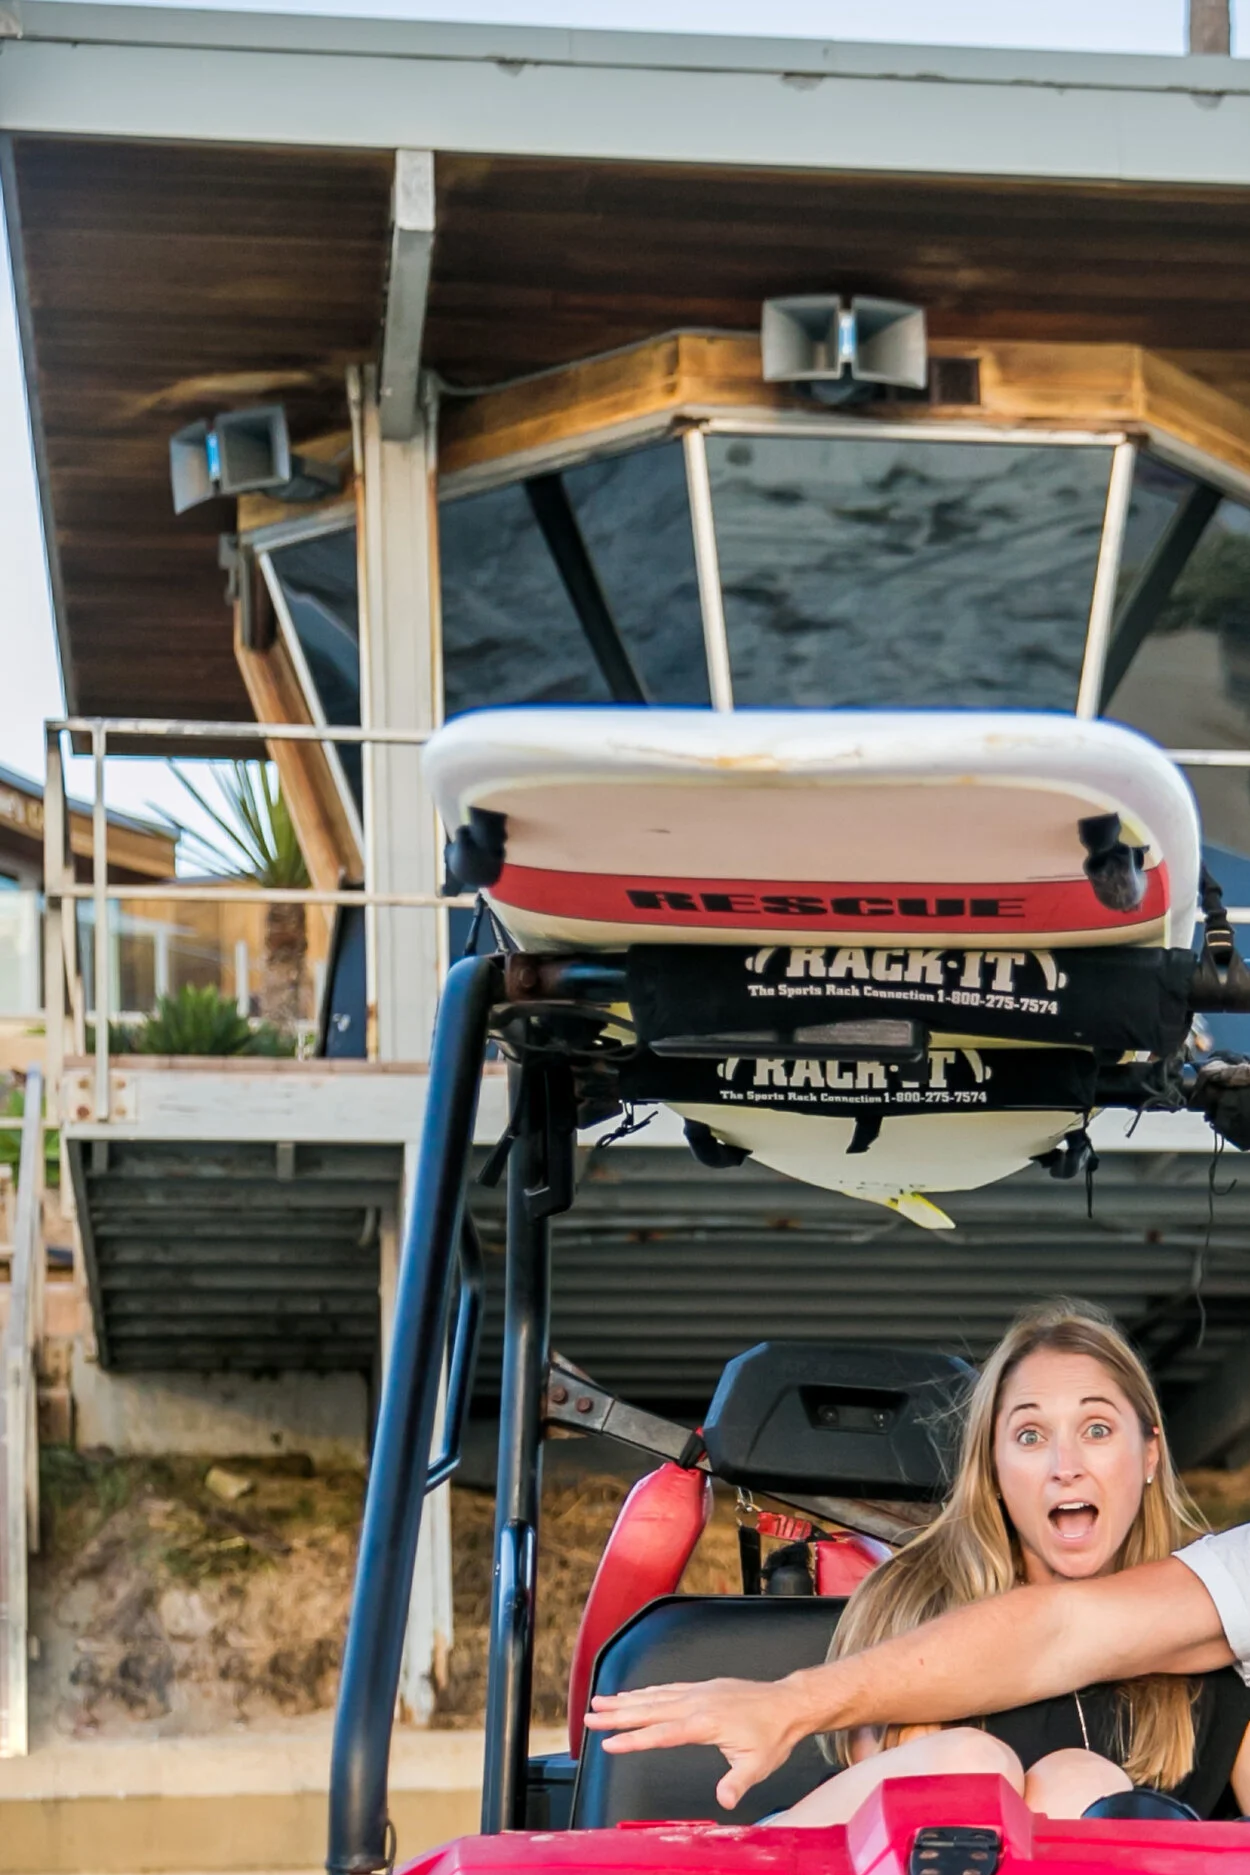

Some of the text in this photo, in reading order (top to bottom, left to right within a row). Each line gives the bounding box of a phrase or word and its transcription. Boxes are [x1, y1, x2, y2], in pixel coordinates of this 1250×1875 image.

[625, 889, 1026, 917] RESCUE
[749, 984, 1059, 1015] The Sports Rack Connection 1-800-275-7574
[720, 1090, 987, 1103] The Sports Rack Connection 1-800-275-7574
